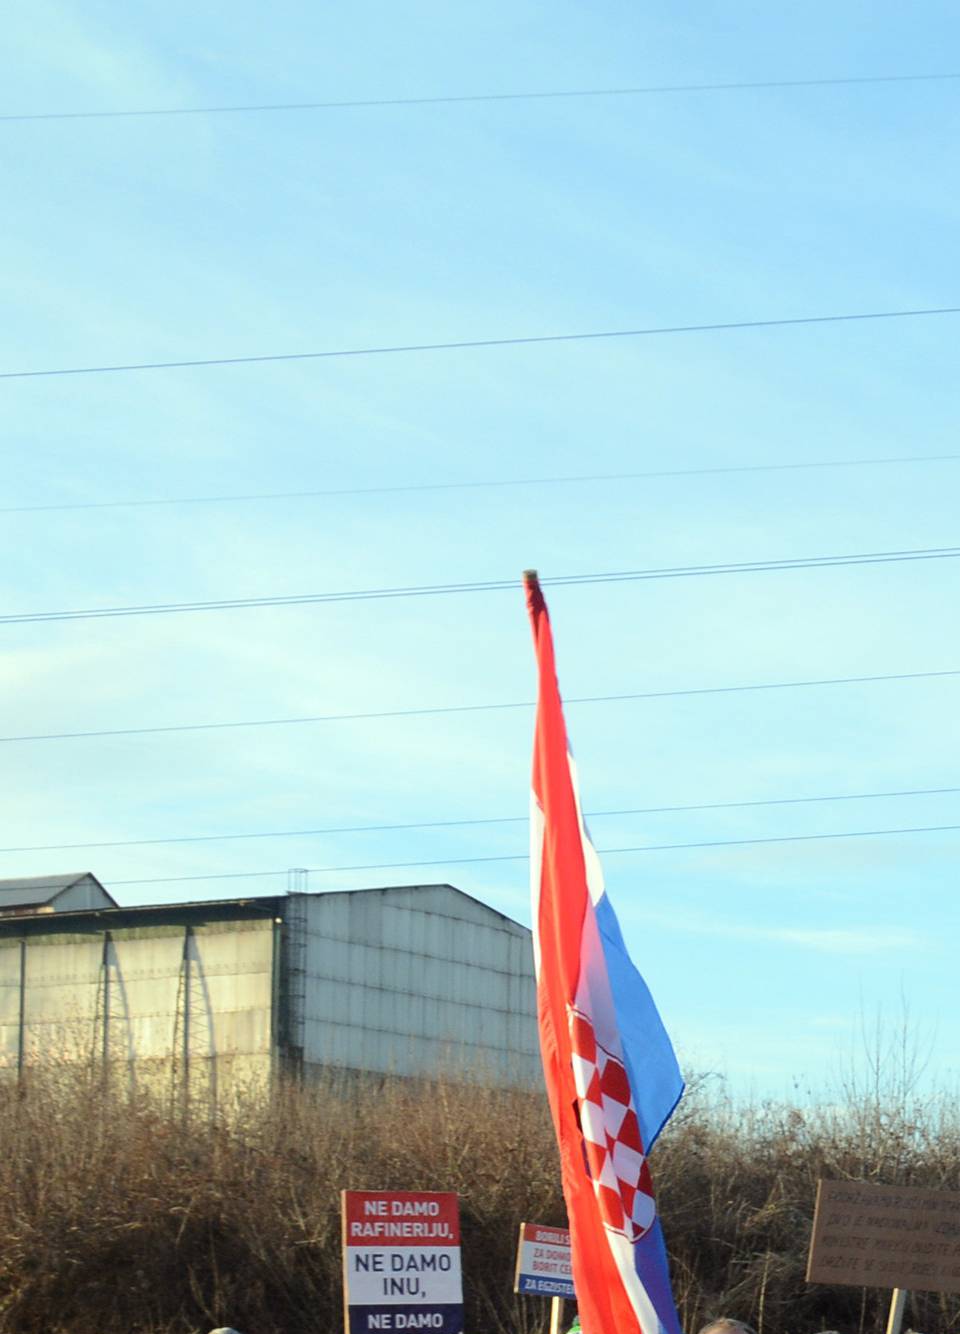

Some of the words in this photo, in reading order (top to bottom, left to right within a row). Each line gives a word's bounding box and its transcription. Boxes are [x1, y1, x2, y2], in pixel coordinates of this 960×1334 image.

[364, 1200, 389, 1216] NE
[391, 1200, 440, 1217] DAMO
[354, 1253, 385, 1273] NE
[391, 1253, 451, 1273] DAMO
[383, 1277, 427, 1298] INU,
[368, 1314, 392, 1329] NE
[395, 1313, 444, 1328] DAMO
